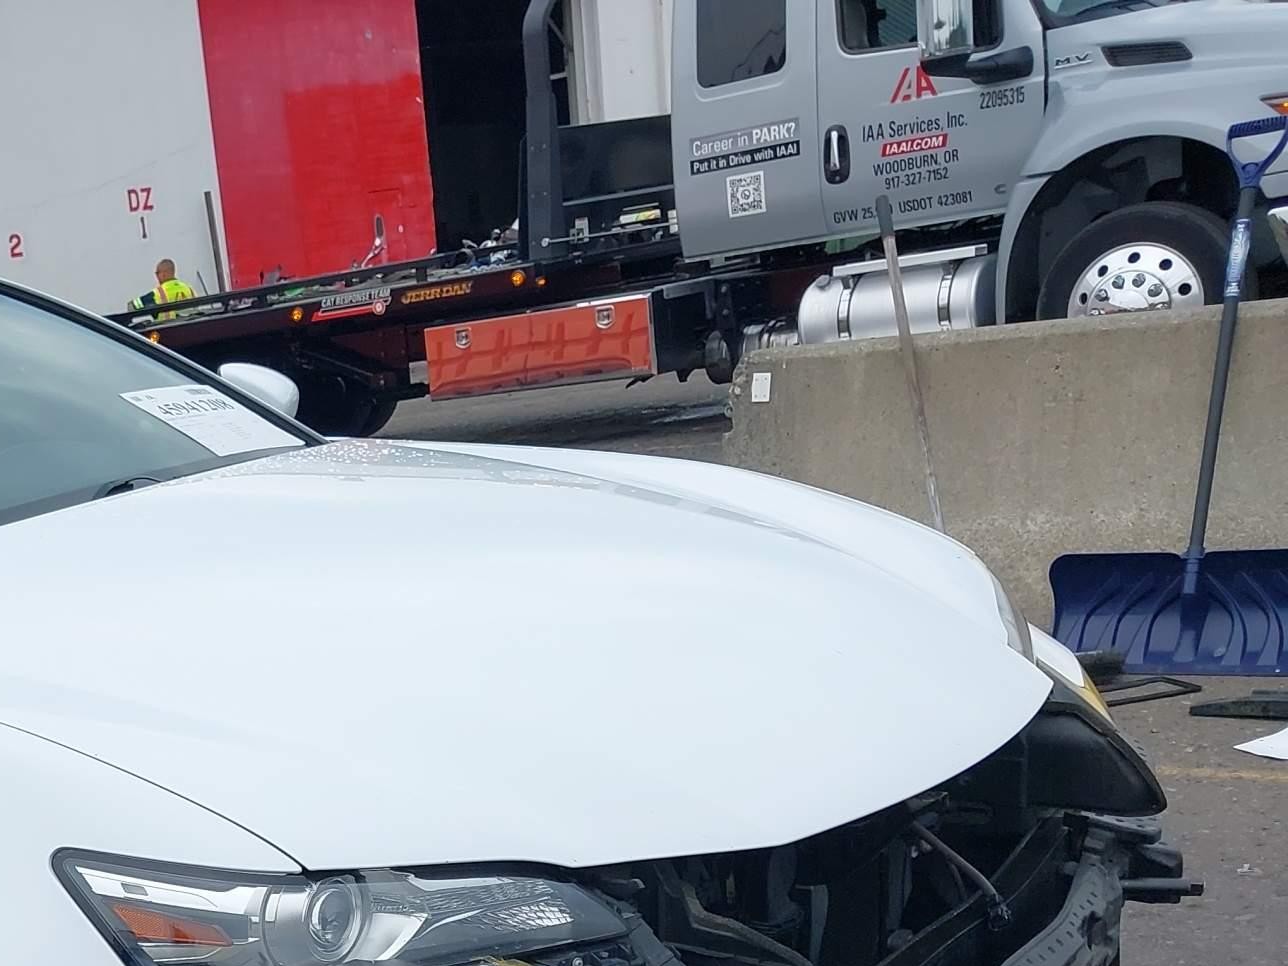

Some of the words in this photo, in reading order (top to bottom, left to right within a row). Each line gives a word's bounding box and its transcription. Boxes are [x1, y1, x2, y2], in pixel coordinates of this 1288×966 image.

[980, 87, 1025, 109] 22095315
[692, 138, 733, 156] Career
[738, 132, 749, 147] in
[752, 122, 796, 144] PARK?
[862, 123, 885, 143] IAA
[889, 116, 944, 138] Services,
[947, 111, 968, 128] Inc.
[693, 160, 709, 173] Put
[711, 158, 717, 169] it
[719, 157, 727, 168] in
[729, 154, 751, 166] Drive
[753, 148, 774, 161] with
[776, 143, 798, 157] IAAI
[885, 136, 944, 155] IAAI.COM
[944, 149, 959, 163] OR
[884, 167, 949, 190] 917-327-7152
[833, 209, 859, 224] GVW
[898, 196, 933, 213] USDOT
[937, 190, 973, 206] 423081
[9, 233, 23, 258] 2
